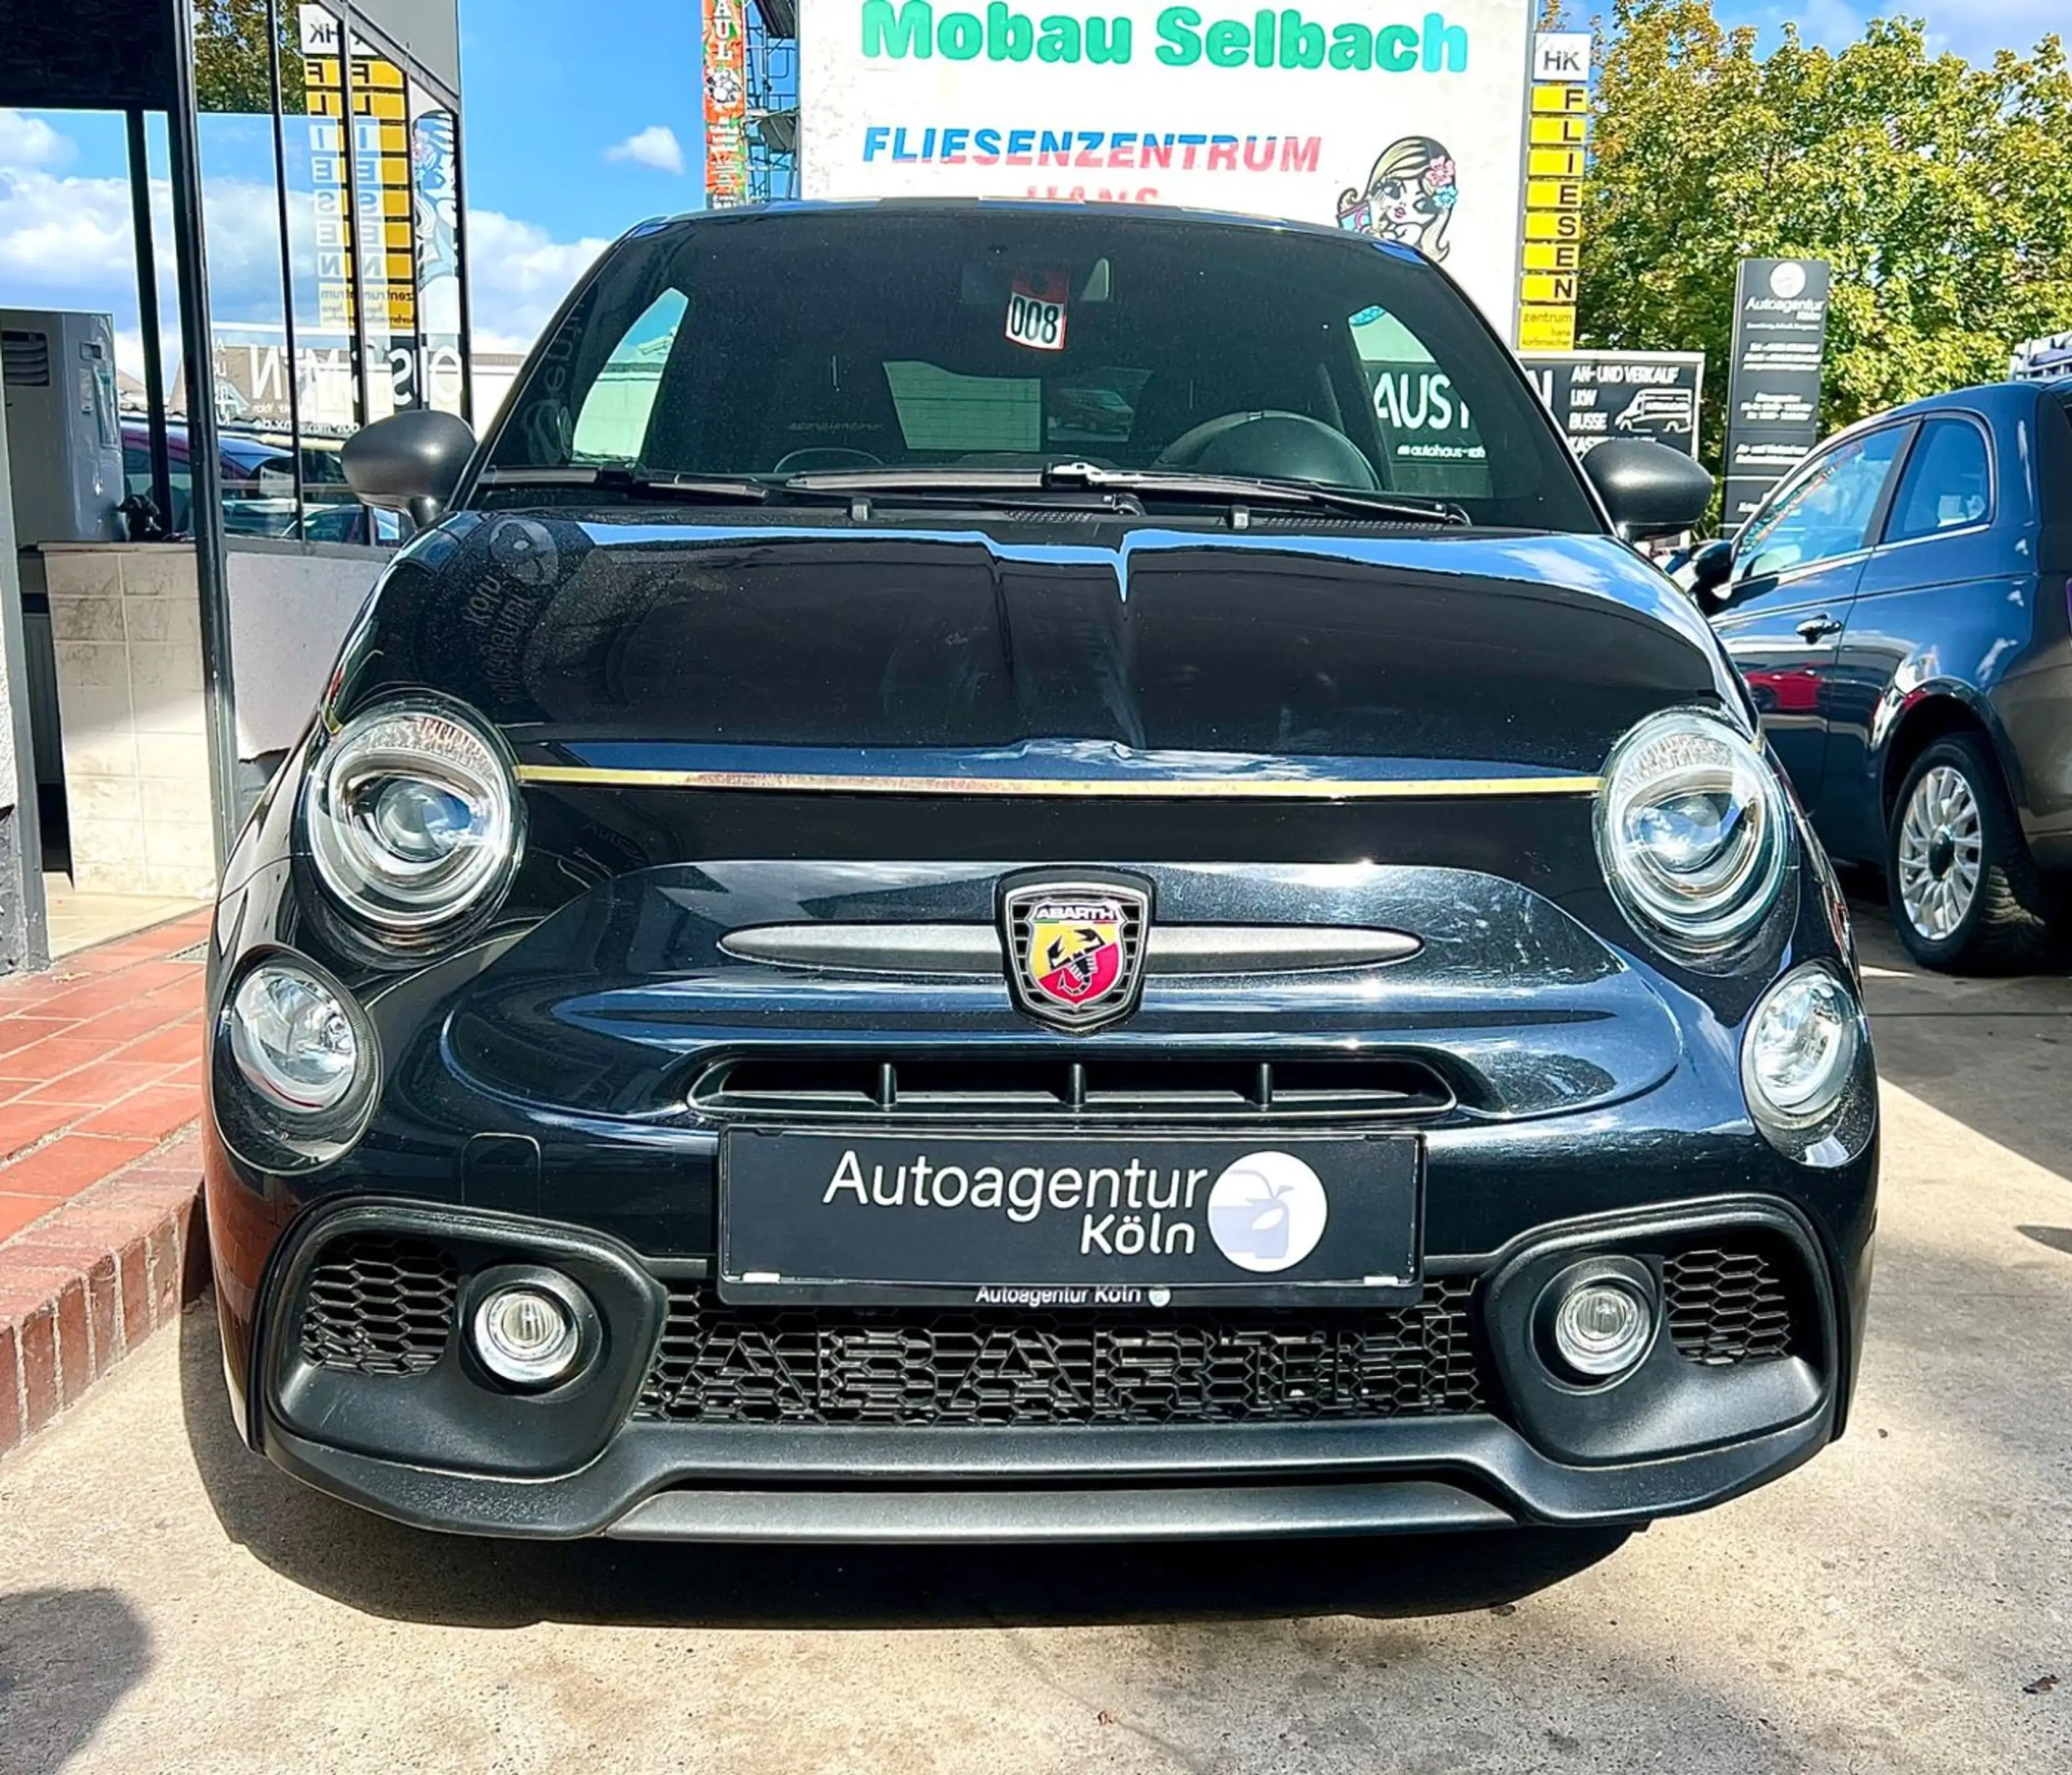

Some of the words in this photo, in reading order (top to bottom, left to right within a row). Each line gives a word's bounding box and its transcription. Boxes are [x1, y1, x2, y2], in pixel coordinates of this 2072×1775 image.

[861, 0, 1132, 64] Mobau
[1154, 6, 1468, 72] Selbach
[1543, 51, 1580, 72] HK
[863, 127, 1322, 173] FLIESENZENTRUM
[1552, 89, 1584, 298] FLIESEN
[1011, 296, 1059, 344] 008
[1523, 312, 1572, 323] zentrum
[1597, 366, 1623, 383] UND
[1625, 366, 1679, 384] VERKAUF
[1568, 412, 1608, 430] BUSSE
[1037, 907, 1116, 920] ABARTH
[823, 1149, 1208, 1223] Autoagentur
[1080, 1213, 1196, 1255] Köln
[975, 1286, 1088, 1307] Autoagentur
[1094, 1286, 1141, 1303] Köln
